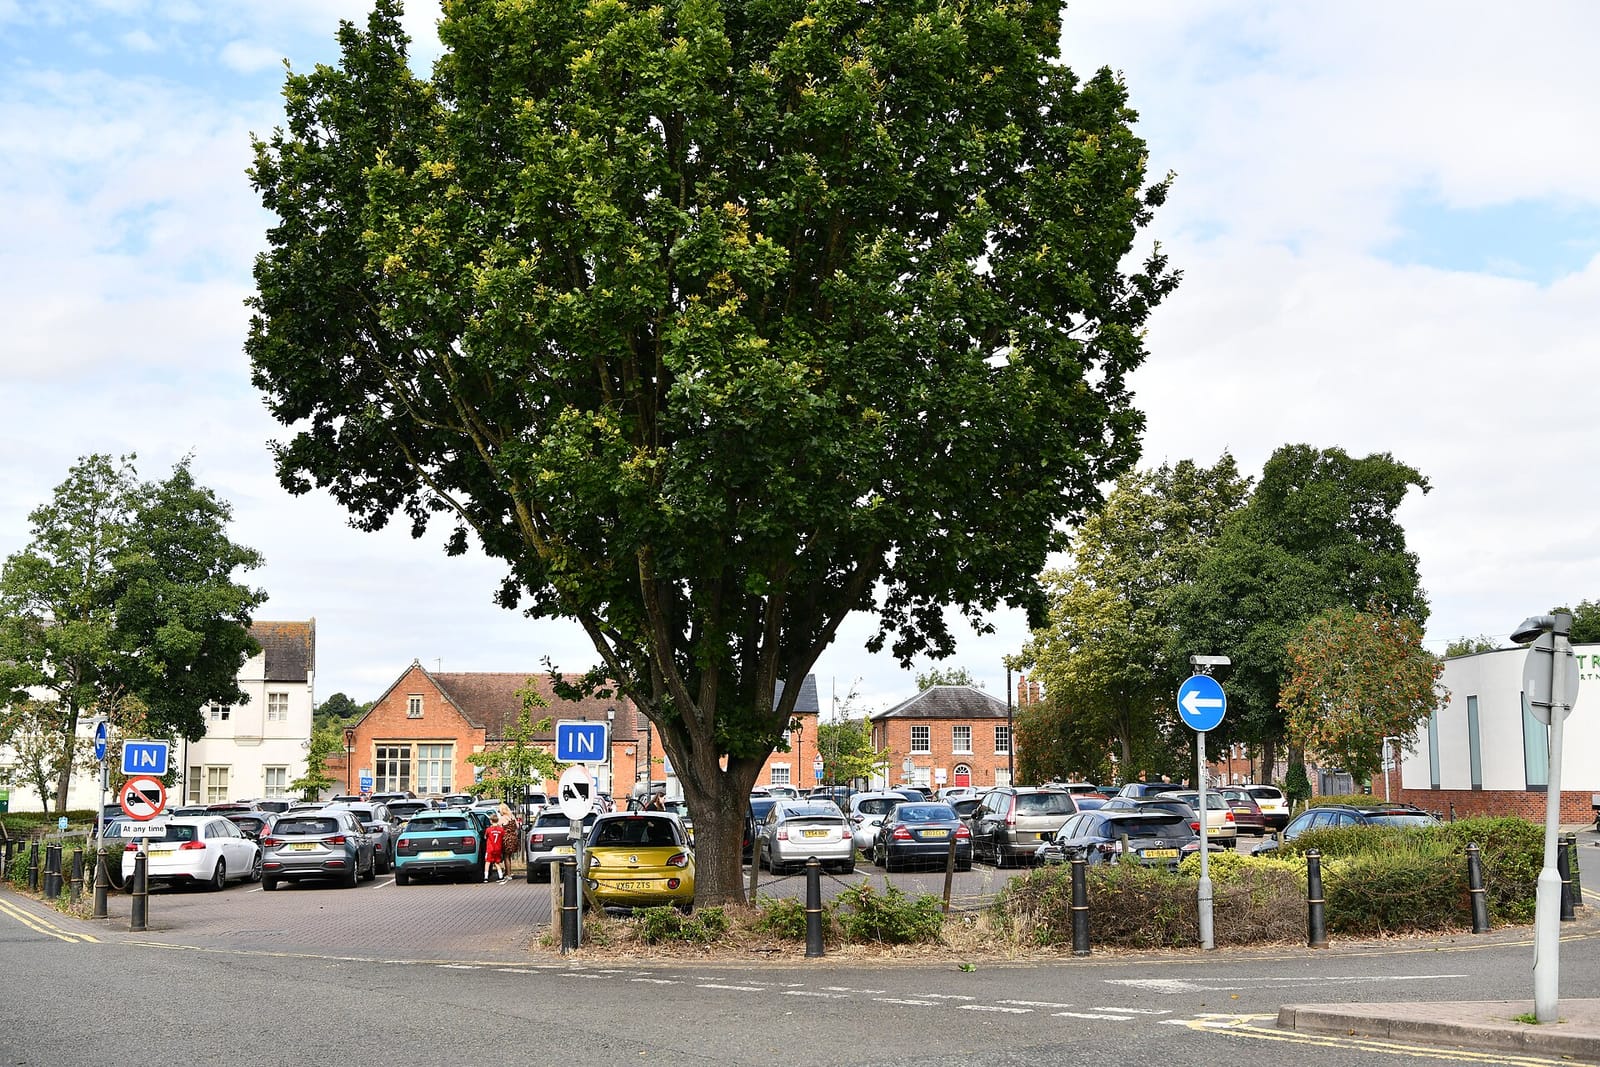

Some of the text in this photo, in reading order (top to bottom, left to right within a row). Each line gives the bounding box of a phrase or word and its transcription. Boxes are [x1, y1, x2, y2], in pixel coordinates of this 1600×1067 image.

[568, 732, 595, 753] IN
[133, 749, 157, 767] IN
[493, 833, 499, 843] 7
[636, 881, 651, 889] ZTS
